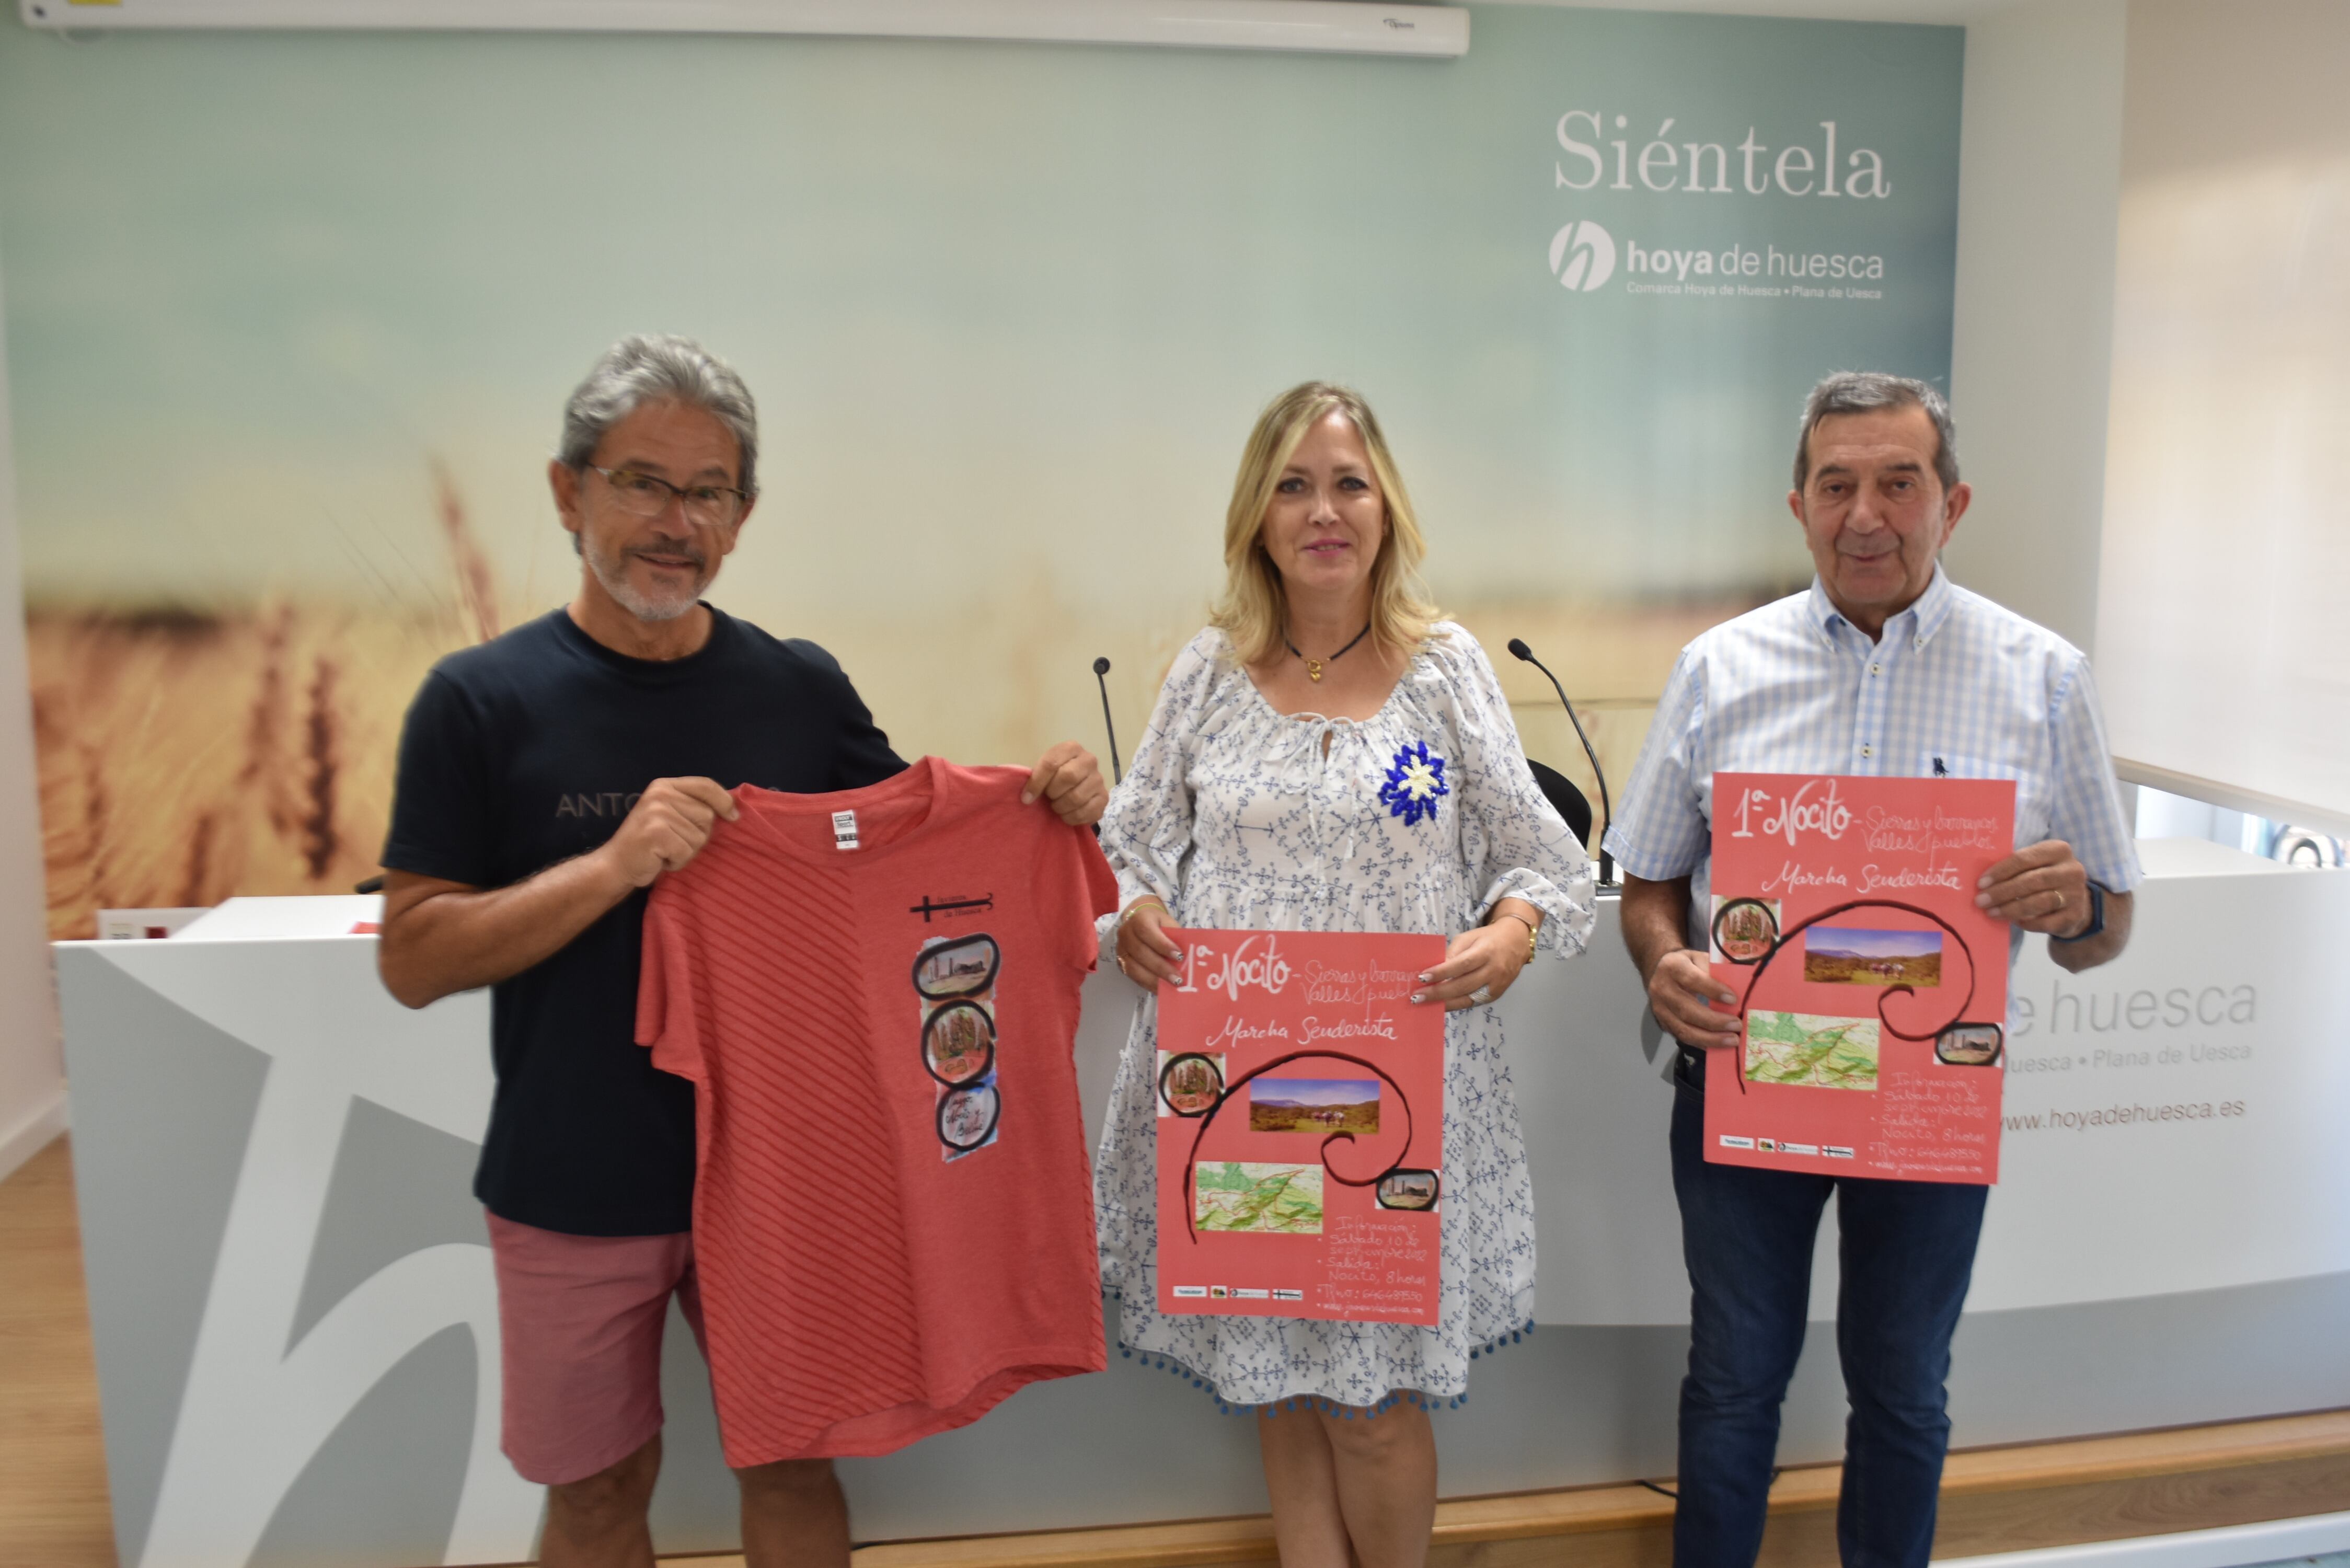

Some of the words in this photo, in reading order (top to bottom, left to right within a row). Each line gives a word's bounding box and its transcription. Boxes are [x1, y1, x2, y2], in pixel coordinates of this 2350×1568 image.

[1556, 110, 1892, 198] Siéntela
[1627, 240, 1712, 281] hoya
[1720, 243, 1760, 276] de
[1768, 244, 1883, 279] huesca
[1627, 282, 1681, 294] Comarca
[1685, 283, 1715, 296] Hoya
[1720, 284, 1734, 296] de
[1738, 285, 1781, 297] Huesca
[1792, 285, 1824, 297] Plana
[1828, 286, 1842, 298] de
[1847, 287, 1882, 299] Uesca
[1761, 860, 1847, 894] Marcha
[1856, 861, 1963, 893] Senderista
[2049, 979, 2257, 1034] huesca
[1206, 1016, 1288, 1048] Marcha
[1298, 1012, 1398, 1044] Senderista
[2005, 1055, 2071, 1074] uesca
[2093, 1048, 2150, 1068] Plana
[2157, 1046, 2182, 1065] de
[2189, 1043, 2252, 1063] Uesca
[1389, 1236, 1402, 1246] 10
[1386, 1271, 1395, 1284] 8
